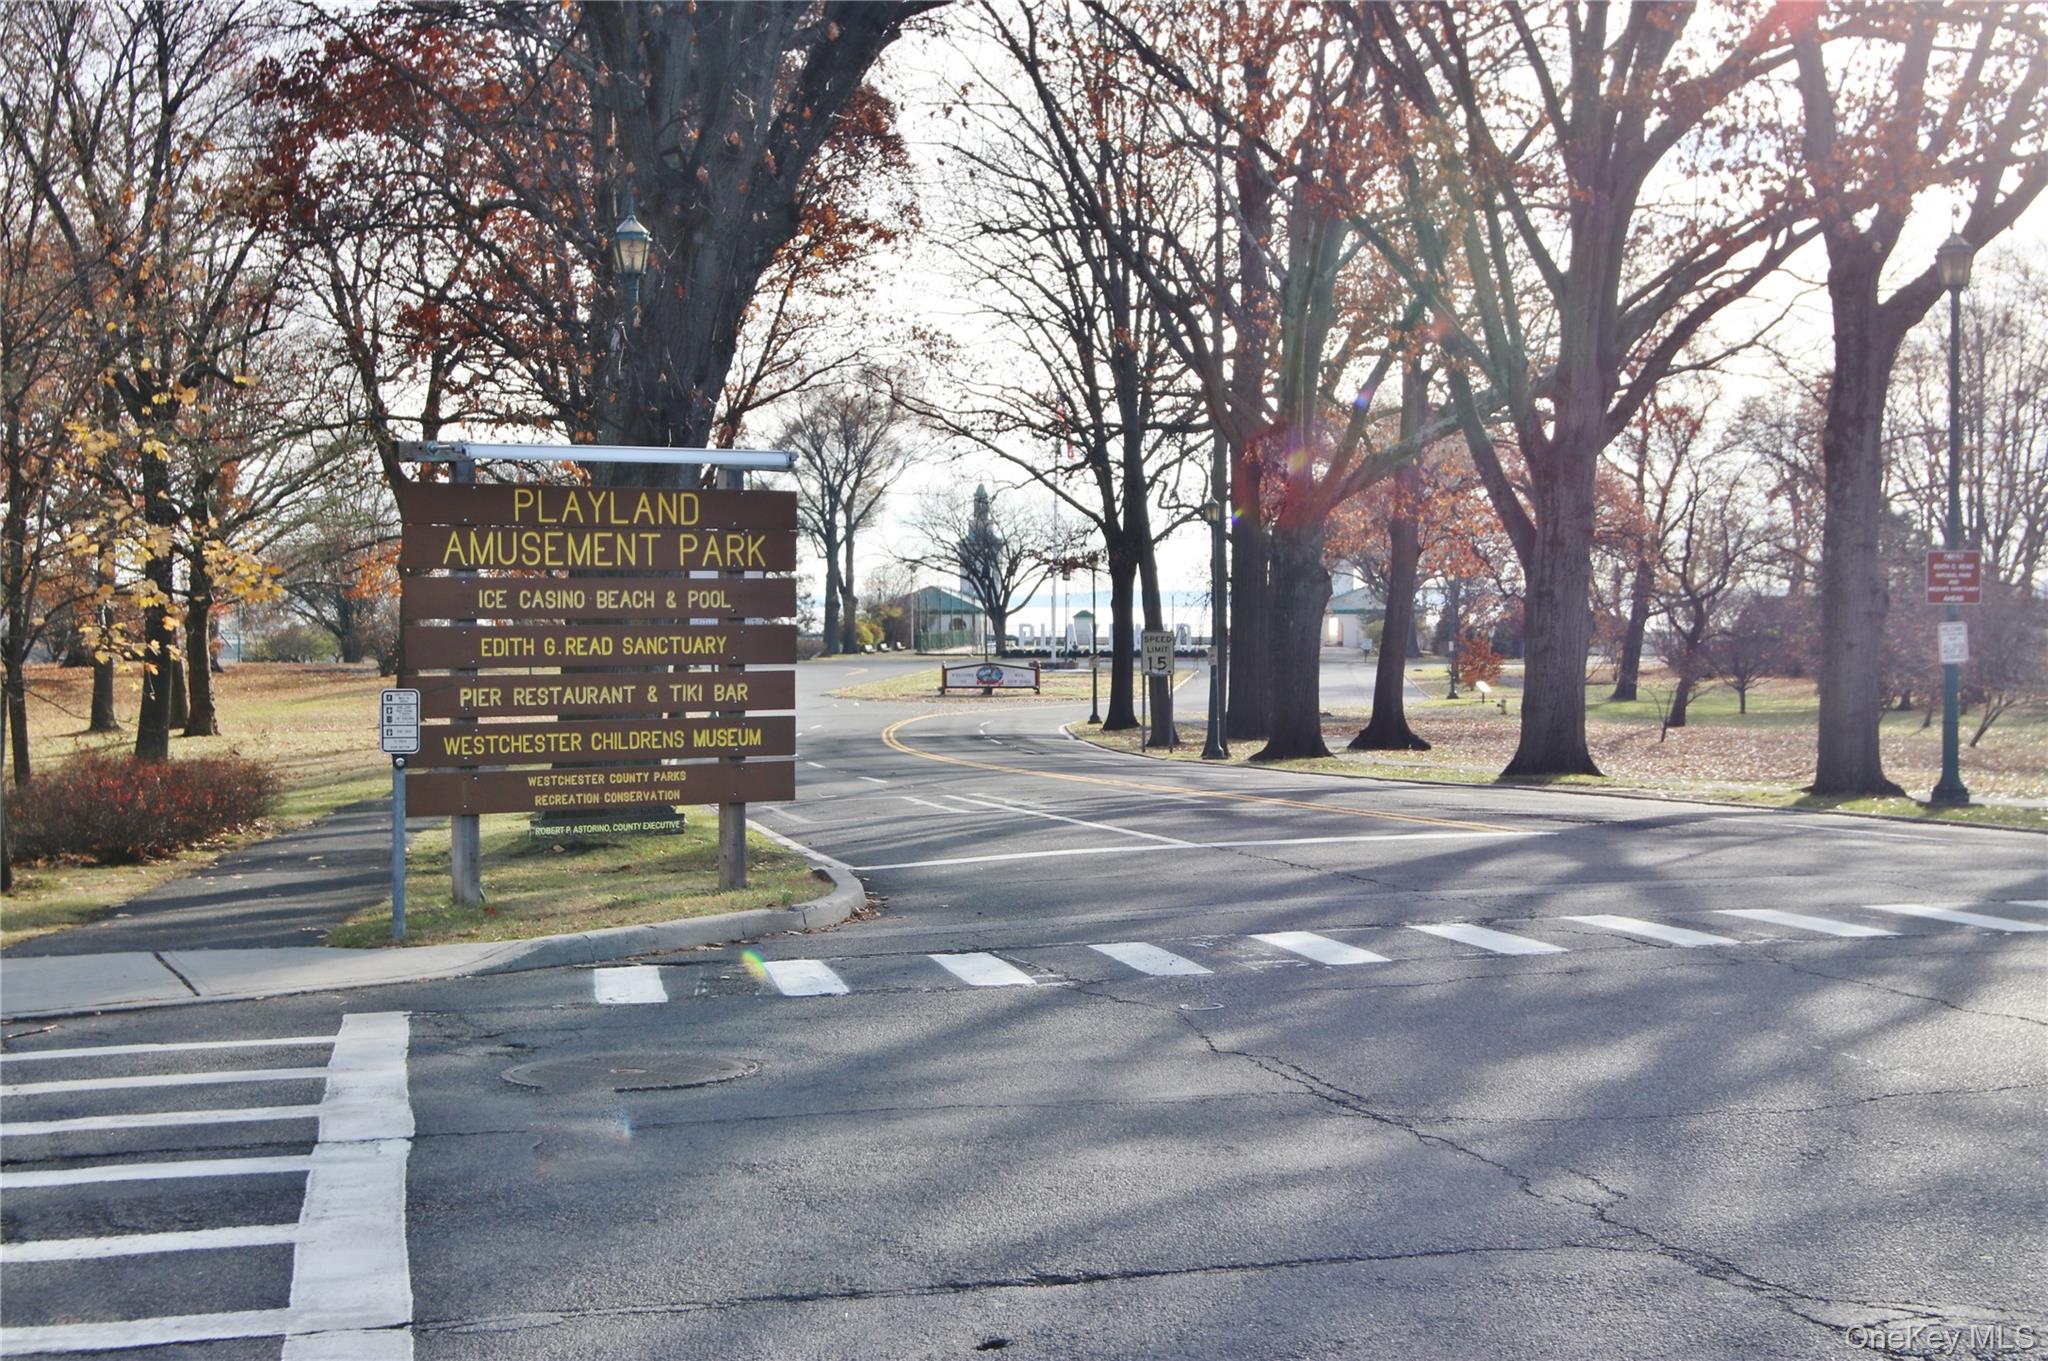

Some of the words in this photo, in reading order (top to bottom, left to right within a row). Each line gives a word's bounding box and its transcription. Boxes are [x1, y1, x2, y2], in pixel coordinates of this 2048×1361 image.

[514, 488, 700, 526] PLAYLAND
[442, 530, 661, 567] AMUSEMENT
[679, 533, 767, 567] PARK
[478, 589, 507, 609] ICE
[519, 589, 586, 609] CASINO
[596, 589, 656, 609] BEACH
[665, 590, 678, 609] &
[687, 589, 732, 609] POOL
[481, 637, 535, 657] EDITH
[622, 635, 728, 656] SANCTUARY
[1144, 635, 1172, 643] SPEED
[1148, 656, 1168, 670] 15
[459, 687, 502, 708] PIER
[513, 685, 637, 707] RESTAURANT
[647, 684, 658, 703] &
[669, 683, 703, 703] TIKI
[713, 682, 749, 702] BAR
[443, 732, 582, 756] WESTCHESTER
[590, 729, 685, 751] CHILDRENS
[693, 728, 762, 748] MUSEUM
[527, 774, 605, 787] WESTCHESTER
[609, 772, 650, 785] COUNTY
[653, 770, 687, 782] PARKS
[534, 792, 600, 807] RECREATION
[604, 789, 681, 803] CONSERVATION
[535, 826, 564, 836] ROBERT
[612, 822, 642, 832] COUNTY
[642, 820, 681, 830] EXECUTIVE
